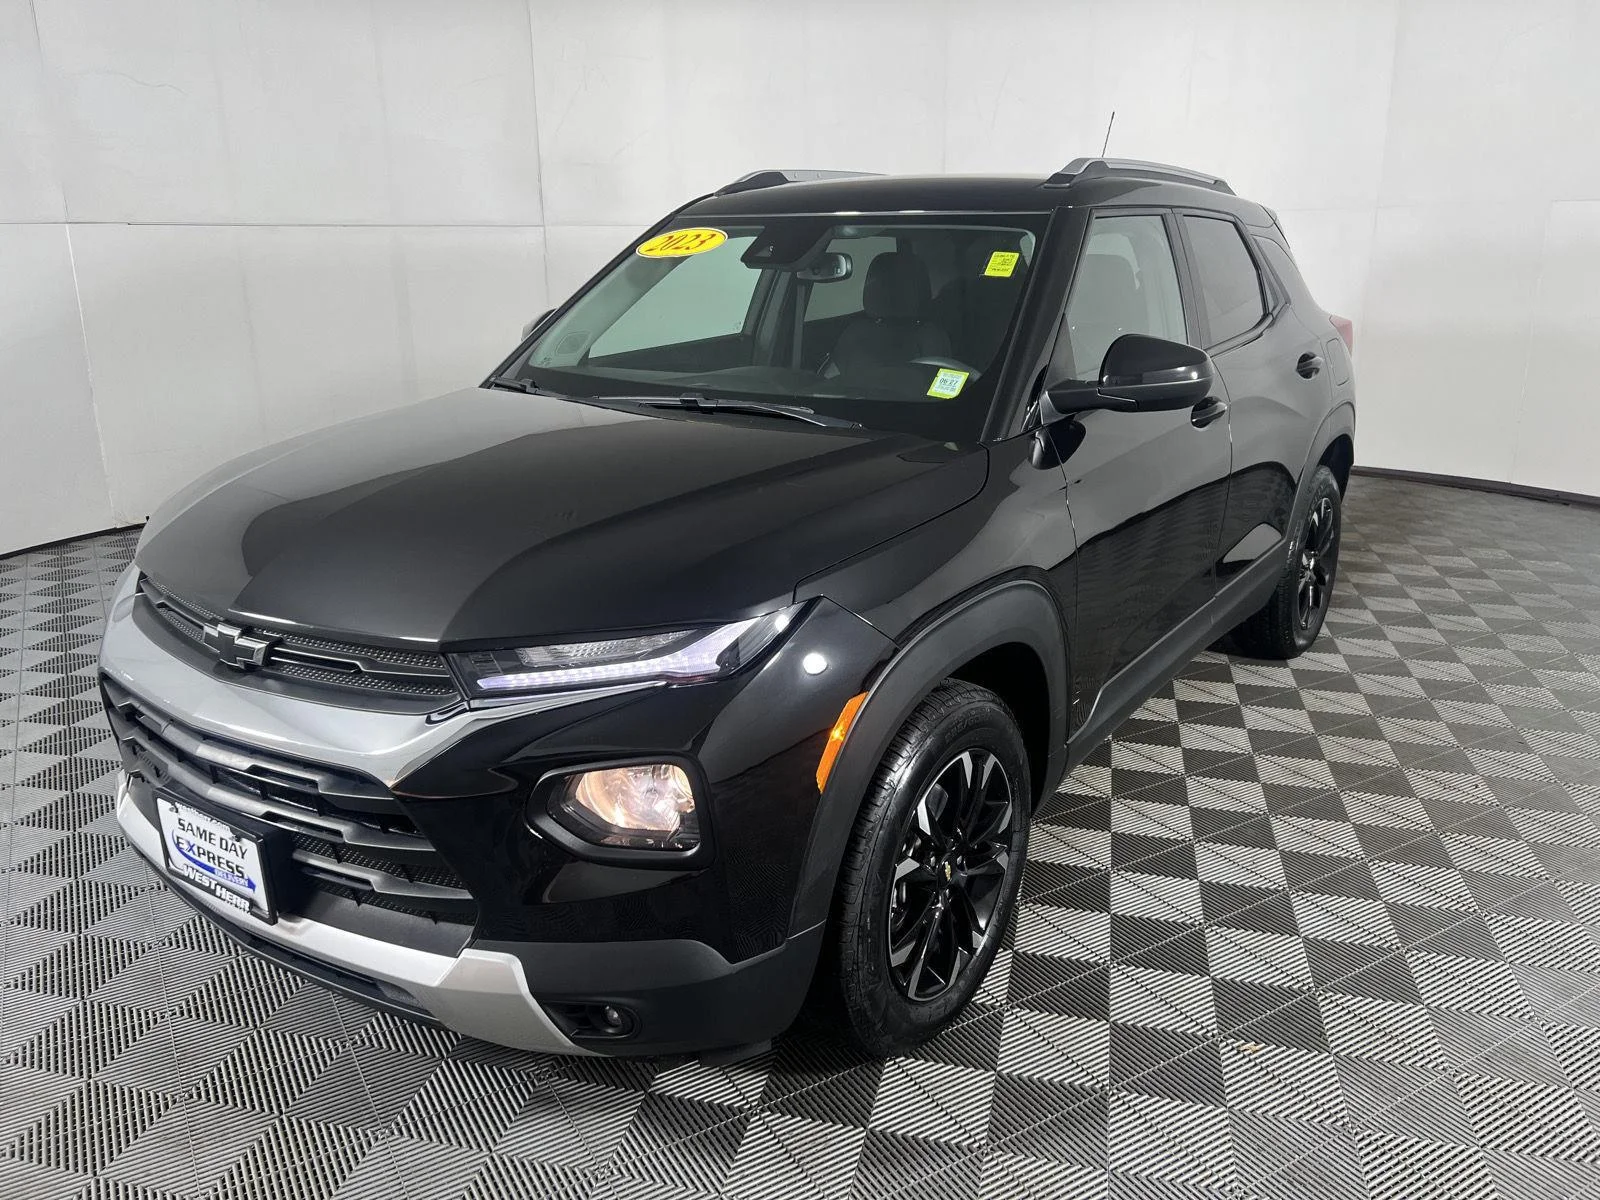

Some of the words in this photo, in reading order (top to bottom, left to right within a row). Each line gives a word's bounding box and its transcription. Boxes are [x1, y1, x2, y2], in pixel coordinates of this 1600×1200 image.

[644, 233, 717, 252] 2023
[176, 836, 245, 878] EXPRESS
[178, 818, 216, 846] SAME
[219, 836, 248, 859] DAY
